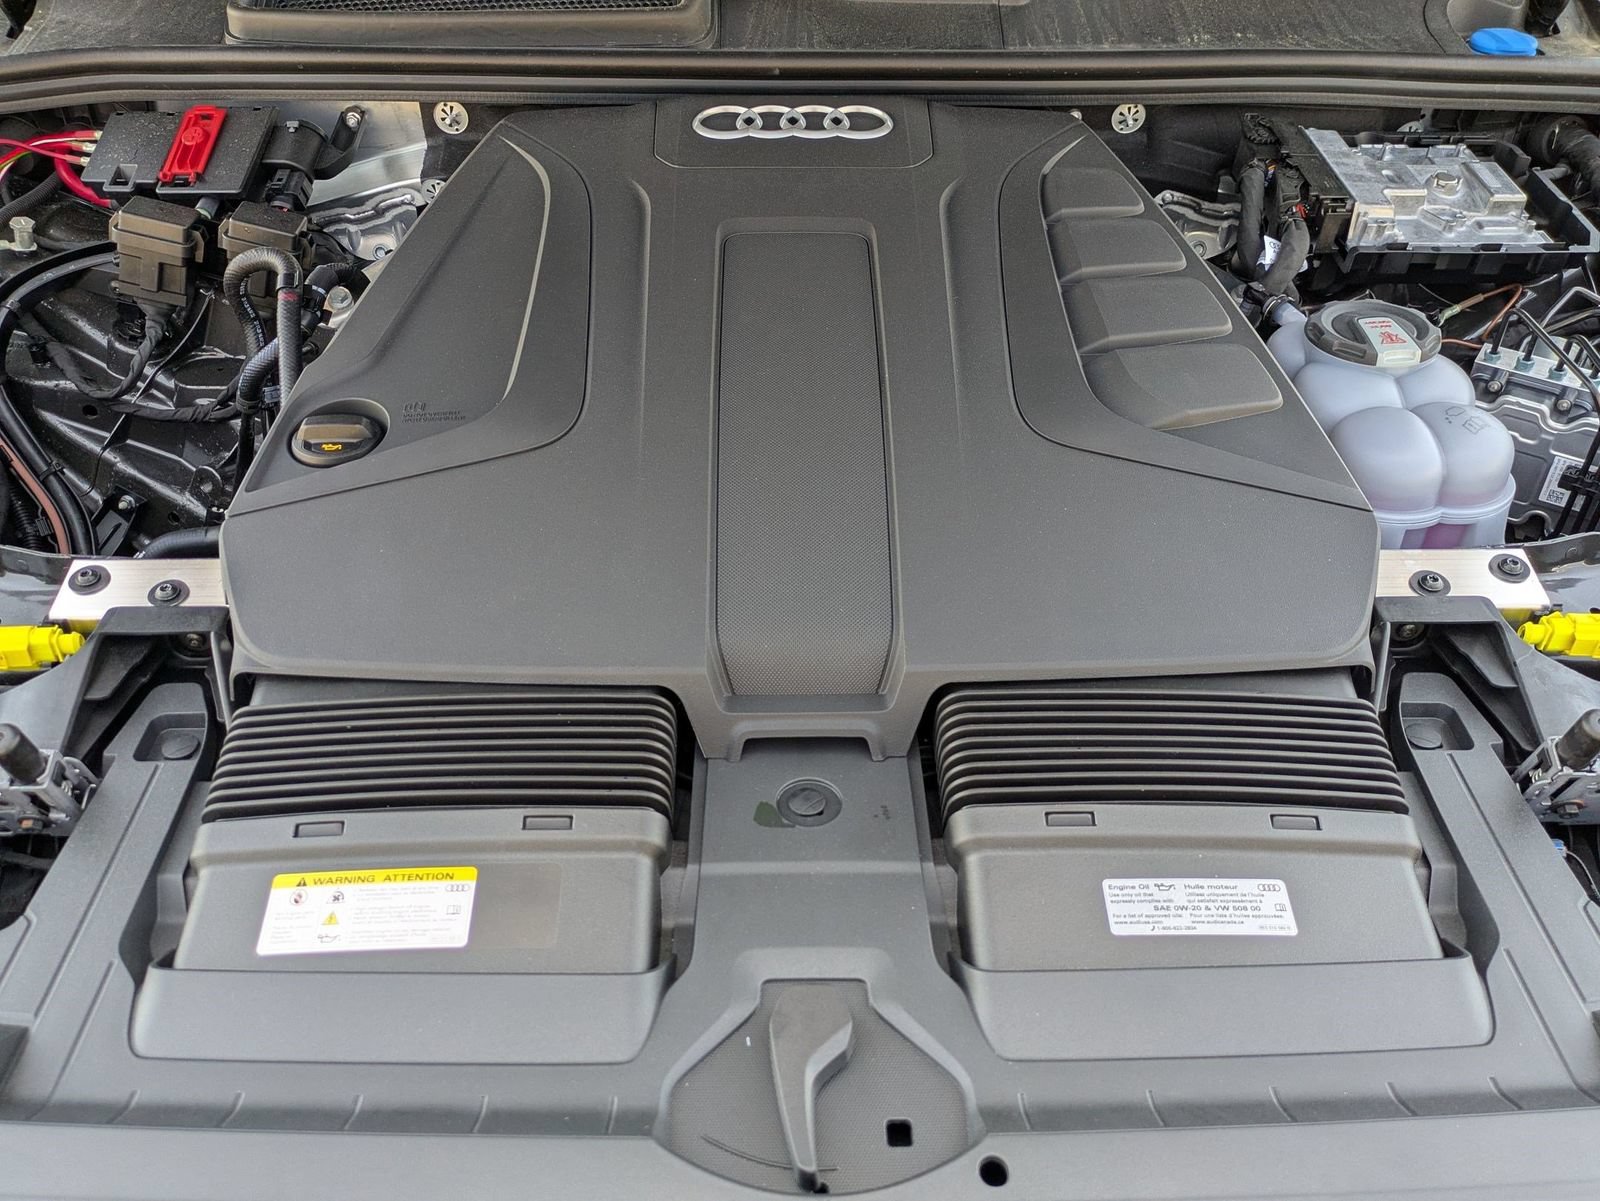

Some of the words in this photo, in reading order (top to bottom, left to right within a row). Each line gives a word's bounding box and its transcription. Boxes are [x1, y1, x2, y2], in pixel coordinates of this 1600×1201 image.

[313, 874, 376, 886] WARNING
[383, 872, 455, 883] ATTENTION
[1108, 883, 1136, 891] Engine
